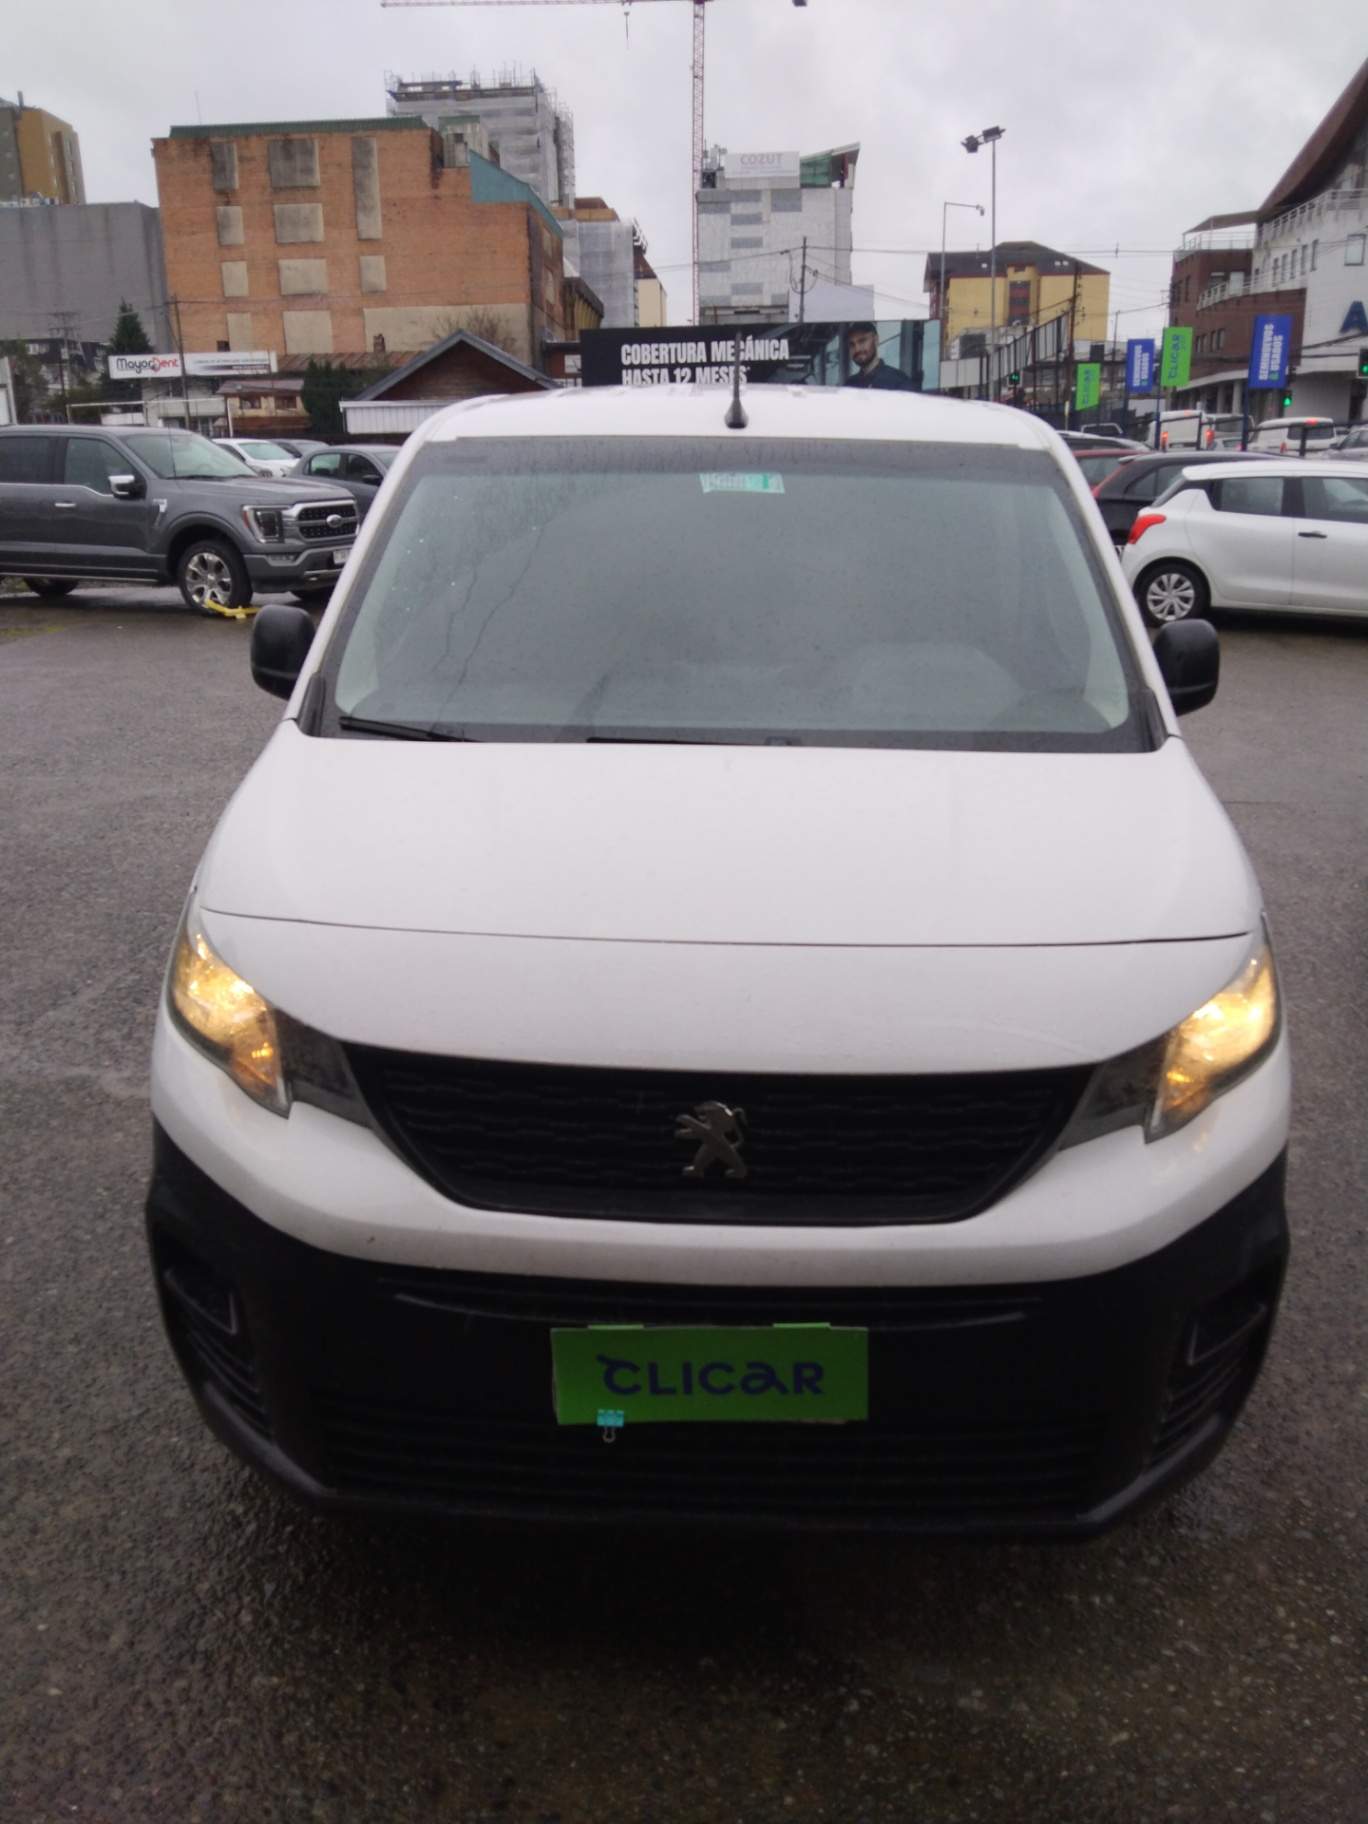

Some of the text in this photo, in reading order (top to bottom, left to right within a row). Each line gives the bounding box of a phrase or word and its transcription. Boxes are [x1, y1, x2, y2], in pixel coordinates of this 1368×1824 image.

[621, 335, 790, 365] COBERTURA MECÁNICA
[622, 368, 670, 385] HASTA
[673, 366, 692, 384] 12
